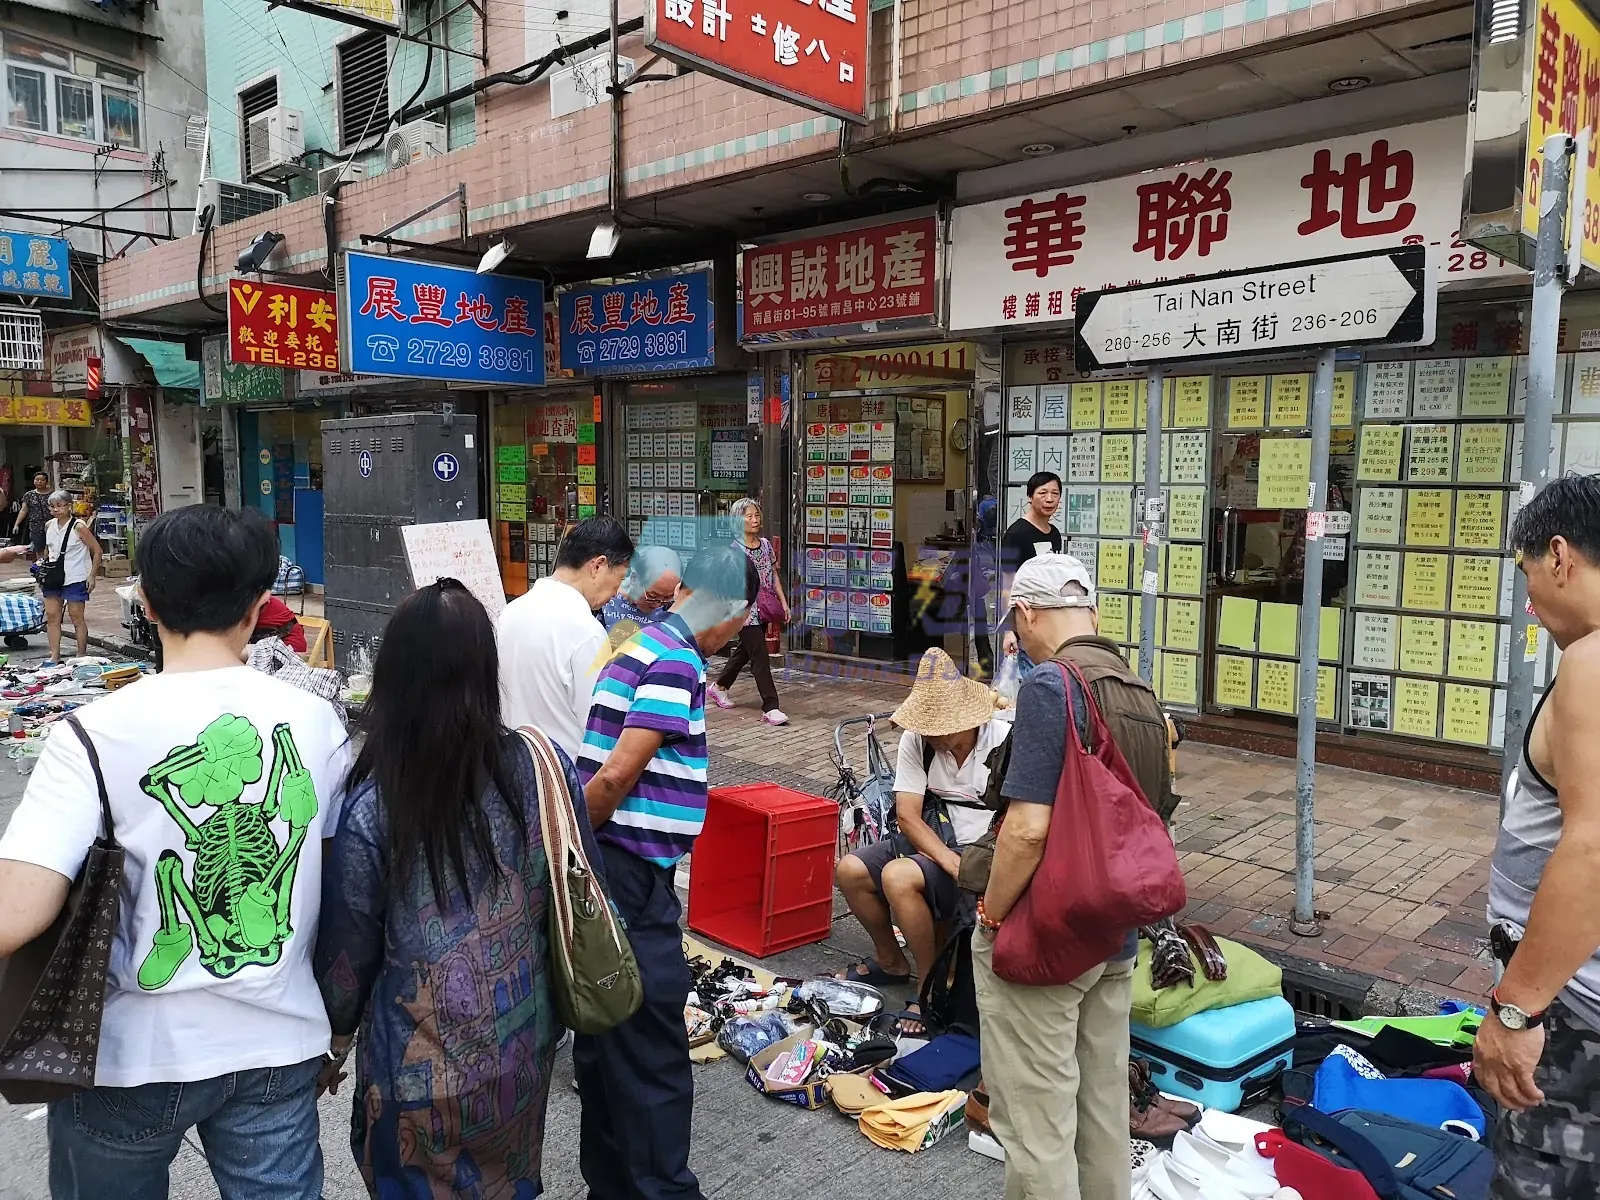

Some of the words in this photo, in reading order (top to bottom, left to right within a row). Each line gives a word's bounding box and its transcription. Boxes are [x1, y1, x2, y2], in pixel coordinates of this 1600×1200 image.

[749, 230, 926, 308] 興誠地產
[360, 276, 536, 337] 展豐地產
[569, 281, 696, 335] 展豐地產
[1153, 290, 1183, 313] Tai
[1190, 285, 1234, 309] Nan
[1242, 273, 1317, 302] Street
[267, 294, 337, 334] 利安
[1104, 331, 1171, 352] 280-256
[1182, 312, 1280, 349] 大南街
[1291, 308, 1378, 333] 236-206
[407, 338, 472, 368] 2729
[479, 344, 534, 373] 3881
[600, 335, 640, 361] 2729
[645, 329, 687, 357] 3881
[1413, 435, 1449, 444] 高層洋樓
[1421, 468, 1436, 476] 299
[1437, 466, 1448, 476] 萬
[748, 1068, 763, 1090] BLUE
